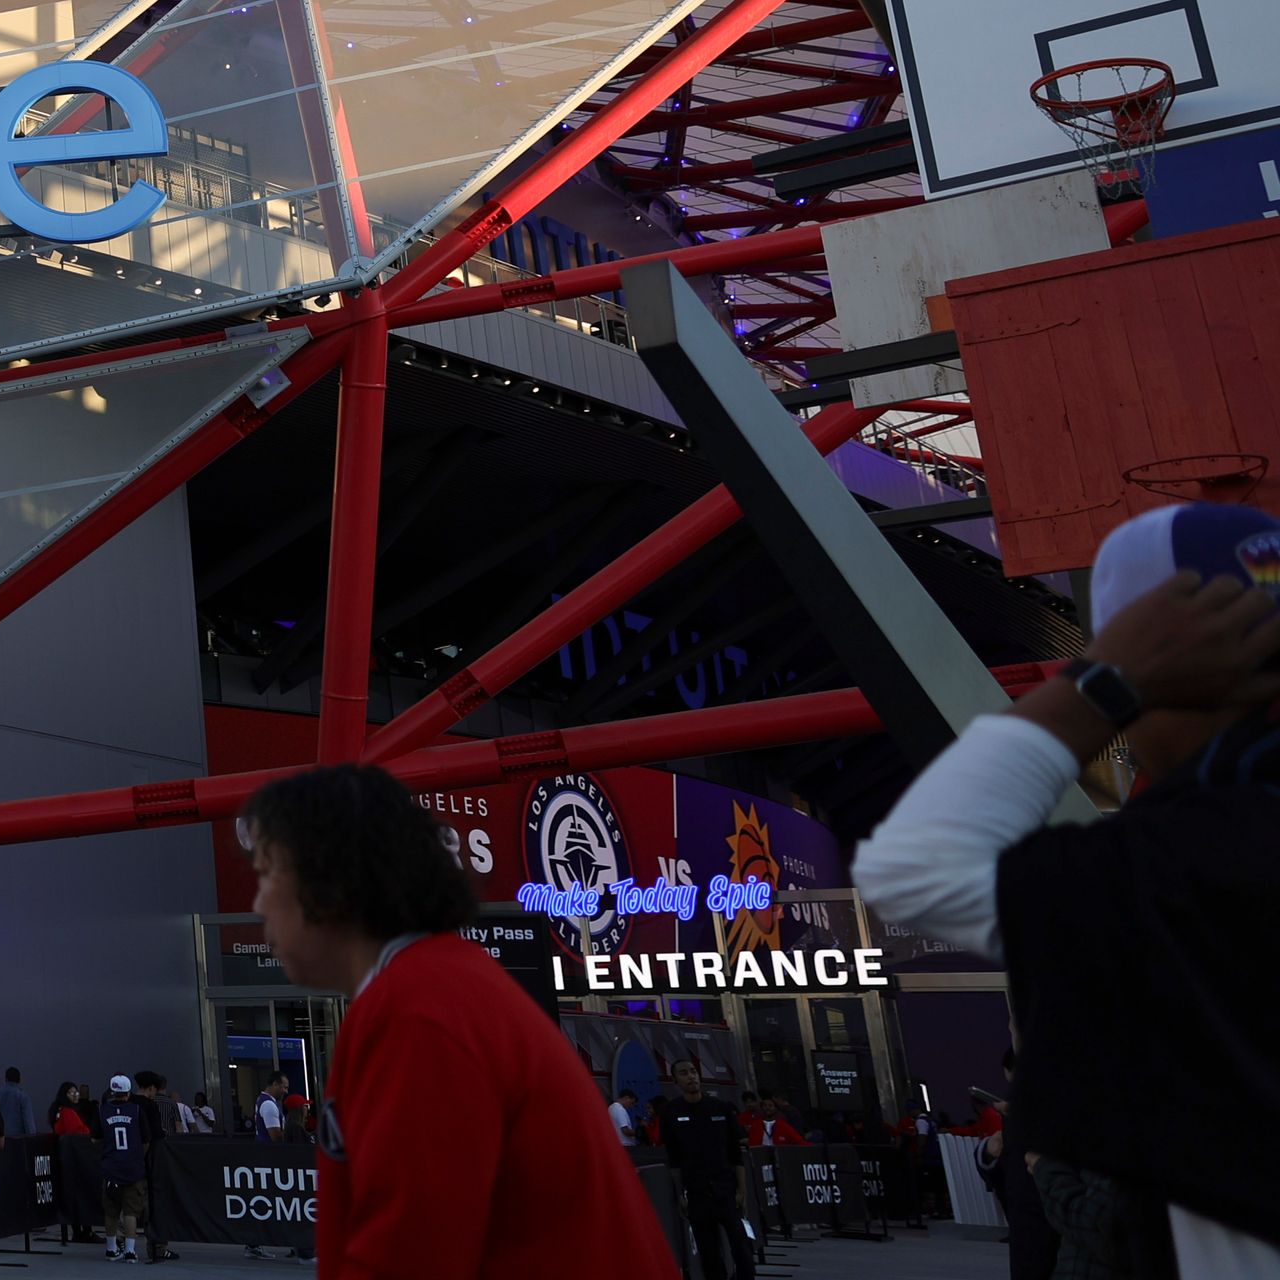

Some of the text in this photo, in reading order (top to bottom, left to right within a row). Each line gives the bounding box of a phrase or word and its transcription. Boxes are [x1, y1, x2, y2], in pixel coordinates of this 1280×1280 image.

[410, 792, 489, 817] GELES
[527, 773, 620, 843] LOS ANGELES
[657, 856, 693, 888] VS
[518, 875, 772, 921] Make Today Epic
[493, 926, 535, 941] Pass
[584, 947, 889, 991] ENTRANCE
[825, 1077, 852, 1086] Portal
[828, 1085, 851, 1094] Lane
[113, 1126, 129, 1151] 0
[223, 1166, 320, 1191] INTUIT
[802, 1163, 838, 1181] INTUT
[225, 1195, 320, 1223] DOME
